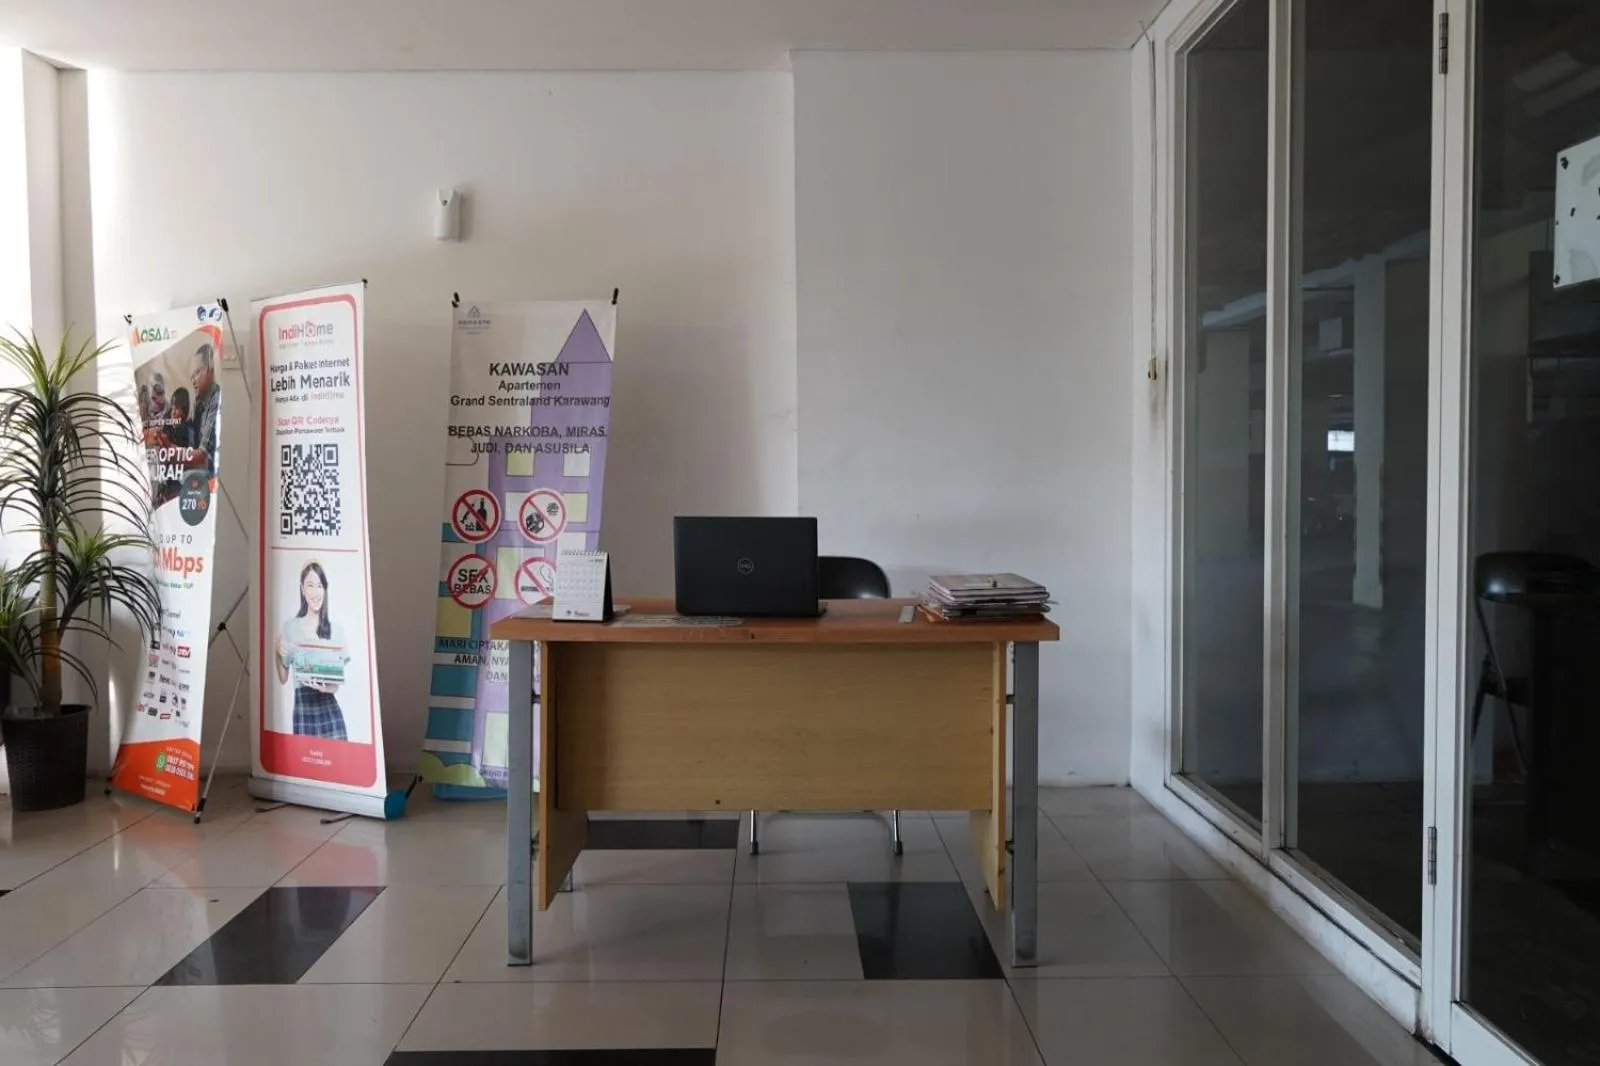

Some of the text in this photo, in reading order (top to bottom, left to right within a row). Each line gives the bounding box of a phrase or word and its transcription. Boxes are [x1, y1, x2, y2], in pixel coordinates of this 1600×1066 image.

[278, 321, 334, 341] IndiHome
[270, 364, 288, 374] Harga
[294, 360, 318, 370] Paket
[318, 357, 350, 368] Internet
[489, 362, 569, 376] KAWASAN
[270, 372, 351, 392] Lebih Menarik
[498, 380, 561, 392] Apartemen
[450, 395, 611, 408] Grand Sentraland Karawang
[448, 425, 491, 437] BEBAS
[494, 426, 562, 438] NARKOBA,
[159, 446, 194, 462] OPTIC
[504, 442, 533, 454] DAN
[538, 442, 590, 454] ASUSILA
[149, 463, 184, 481] URAH
[182, 498, 197, 510] 270
[180, 534, 193, 545] TO
[457, 568, 489, 583] SEX
[454, 584, 492, 595] BEBAS
[438, 639, 466, 649] MARI
[487, 671, 508, 681] DAN
